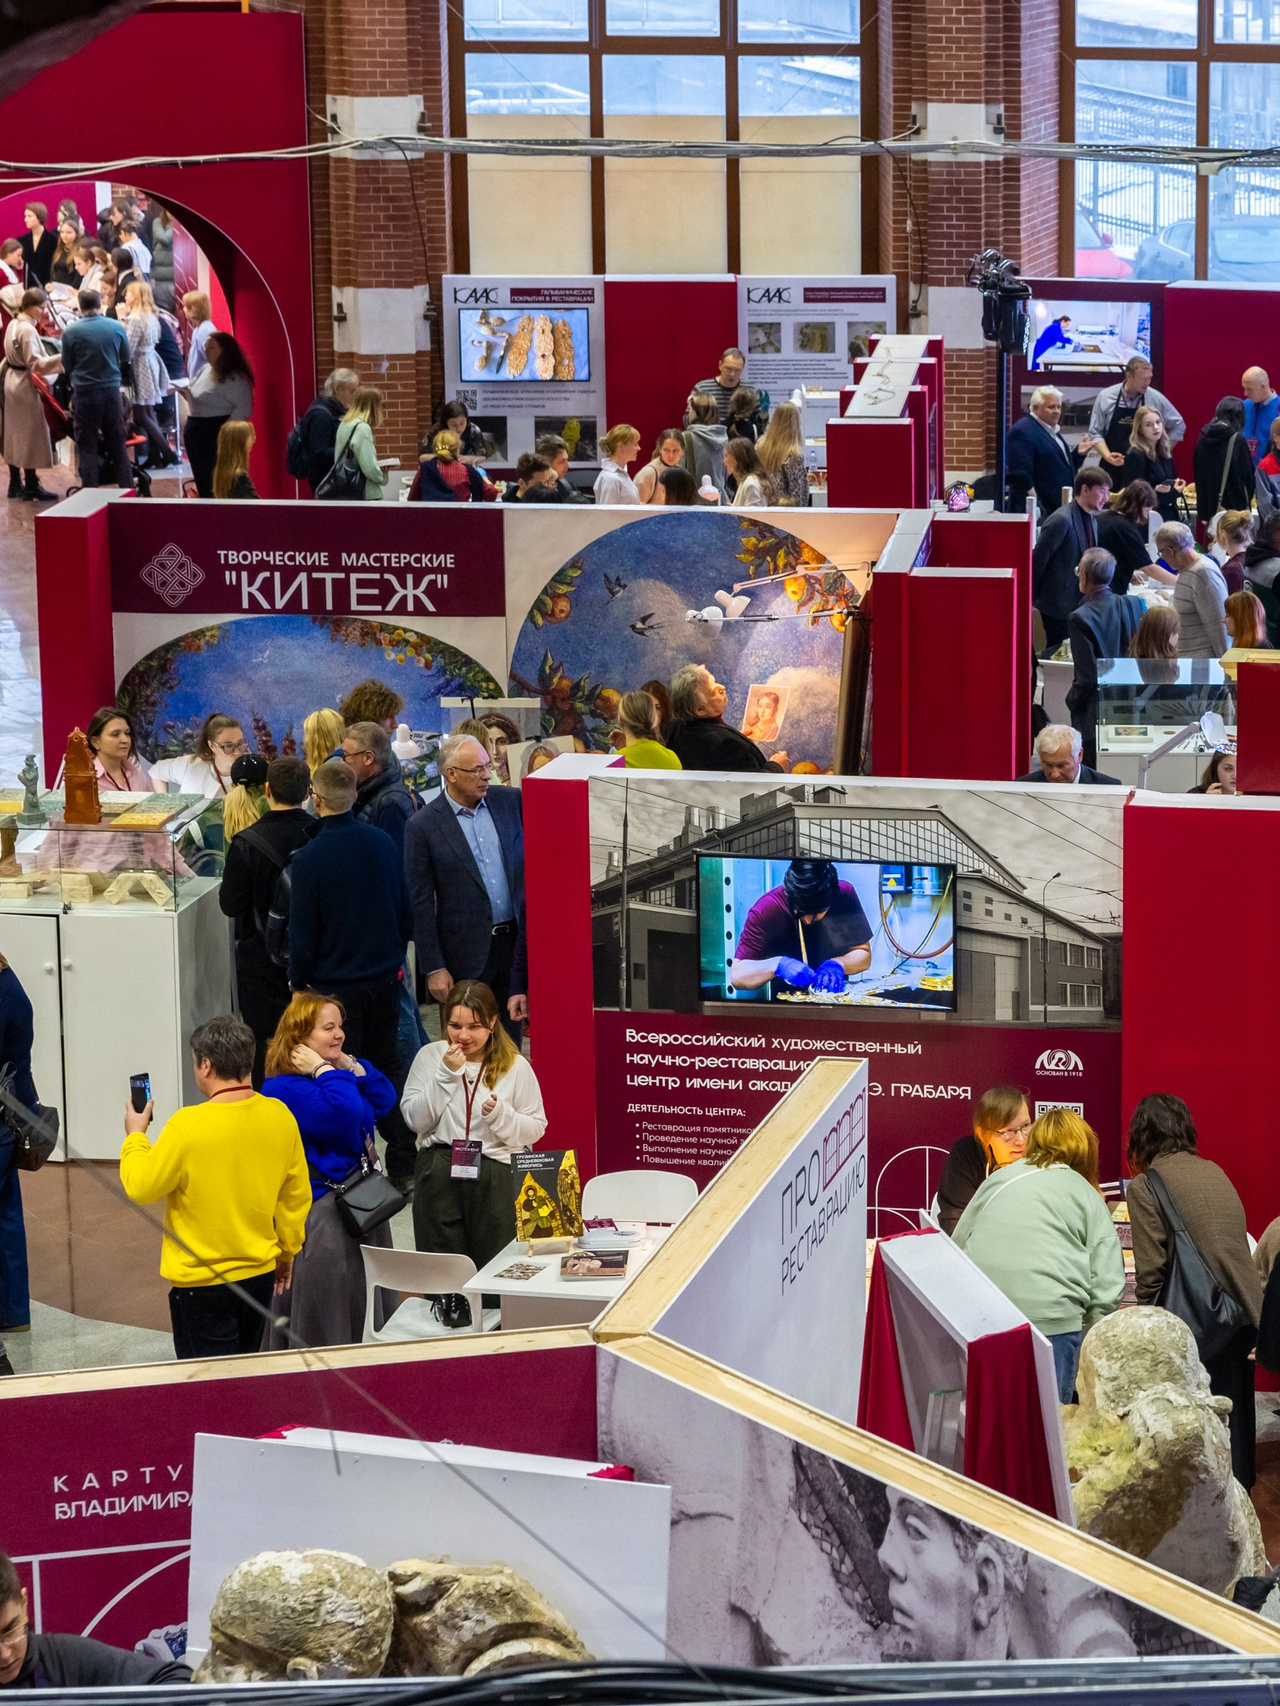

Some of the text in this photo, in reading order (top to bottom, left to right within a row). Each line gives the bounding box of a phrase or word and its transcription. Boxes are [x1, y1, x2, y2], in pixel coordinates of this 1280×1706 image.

[217, 550, 455, 568] ТВОРЧЕСКИЕ МАСТЕРСКИЕ
[225, 571, 448, 612] "КИТЕЖ"
[626, 1028, 922, 1055] Всероссийский художественный
[626, 1074, 972, 1100] центр имени акад Э. ГРАБАРЯ
[627, 1103, 746, 1117] ДЕЯТЕЛЬНОСТЬ ЦЕНТРА:
[642, 1122, 701, 1133] Реставрация
[642, 1133, 698, 1144] Проведение
[700, 1136, 738, 1146] научной
[643, 1144, 735, 1157] Выполнение научно-
[643, 1155, 696, 1166] Повышение
[782, 1149, 820, 1246] ПРО
[781, 1153, 866, 1297] РЕСТАВРАЦИЮ
[55, 1489, 193, 1520] ВЛАДИМИР
